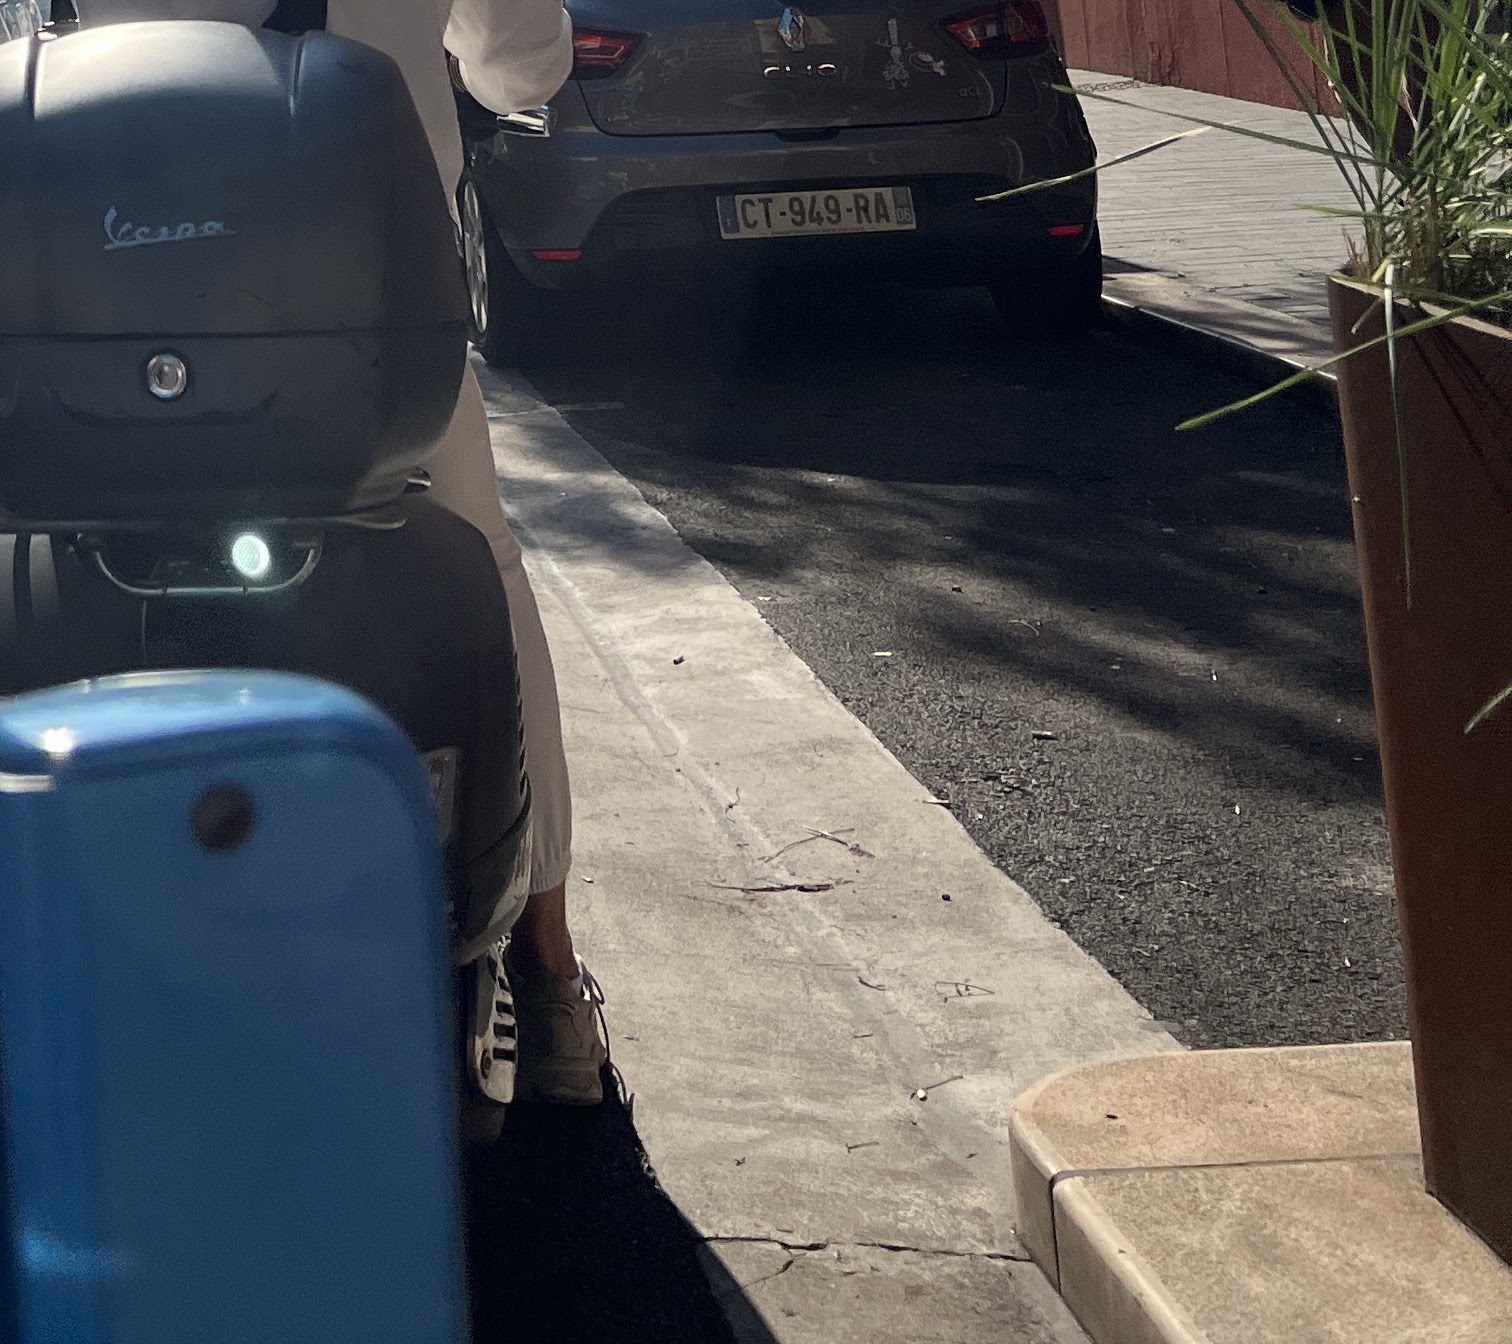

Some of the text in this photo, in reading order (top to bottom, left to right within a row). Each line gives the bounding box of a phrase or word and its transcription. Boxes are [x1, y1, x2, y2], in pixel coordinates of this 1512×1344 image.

[104, 205, 239, 250] Vespa
[740, 191, 891, 230] CT-949-RA
[896, 207, 912, 222] 06
